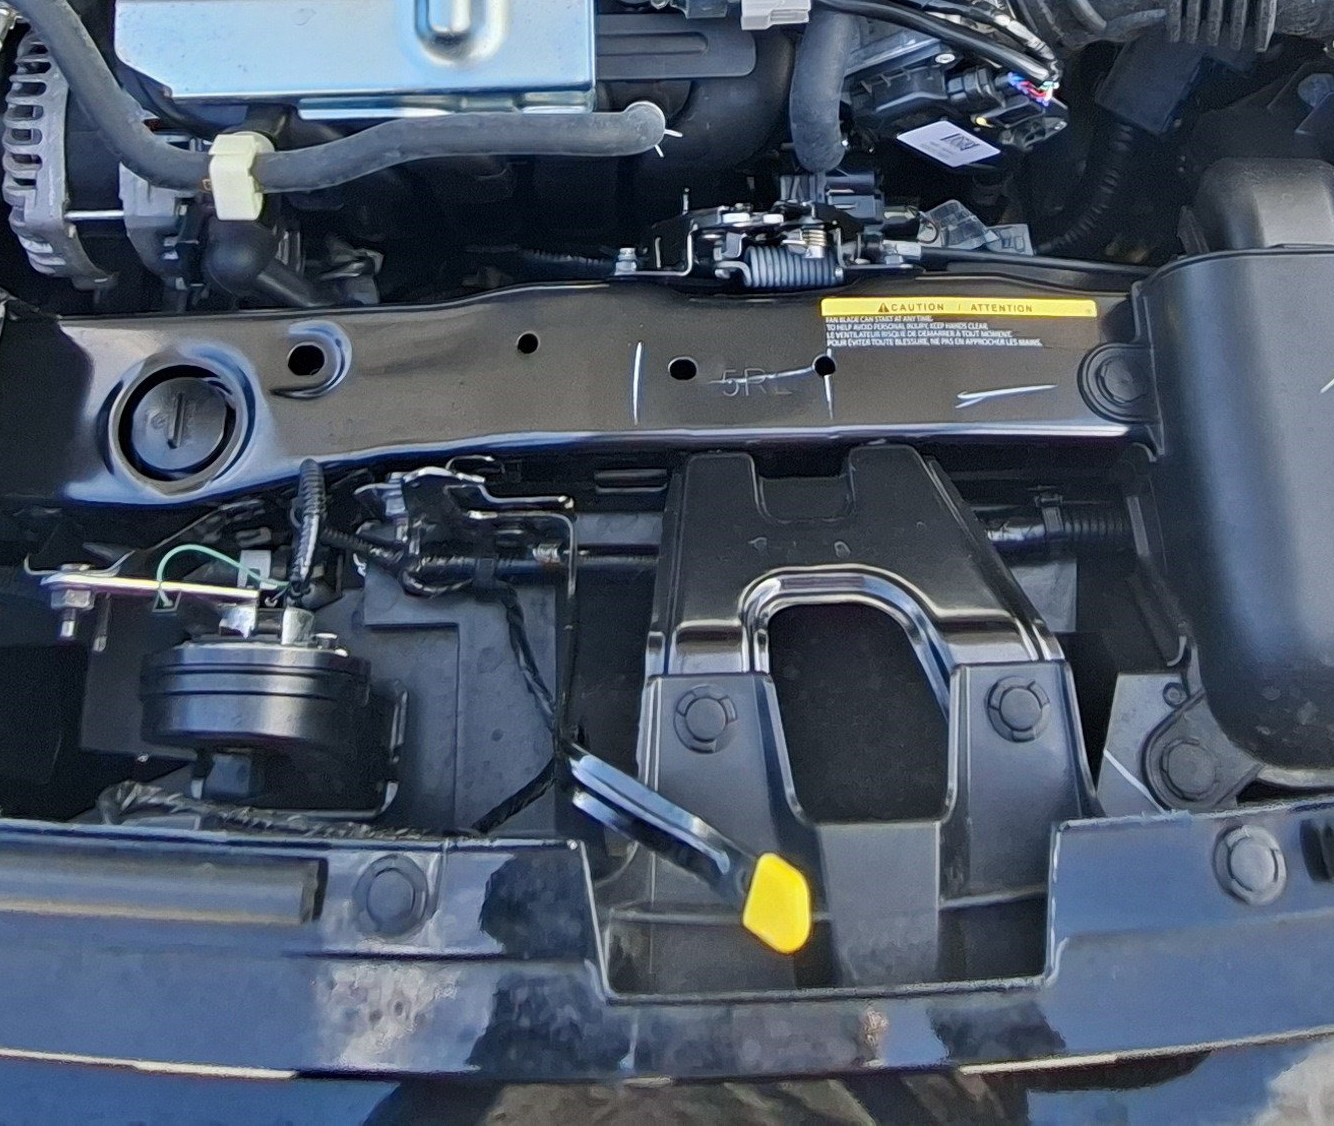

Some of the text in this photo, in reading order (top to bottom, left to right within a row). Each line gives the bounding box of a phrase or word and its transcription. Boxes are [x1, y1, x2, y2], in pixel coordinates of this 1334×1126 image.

[891, 303, 945, 312] CAUTION
[970, 303, 1033, 313] ATTENTION
[860, 315, 874, 323] CAN
[826, 322, 836, 330] TO
[836, 322, 852, 330] HELP
[873, 322, 906, 330] PERSONAL
[835, 330, 881, 339] VENTILATEUR
[907, 330, 916, 339] DE
[961, 330, 979, 339] TOUT
[827, 337, 847, 347] POUR
[871, 337, 894, 347] TOUTE
